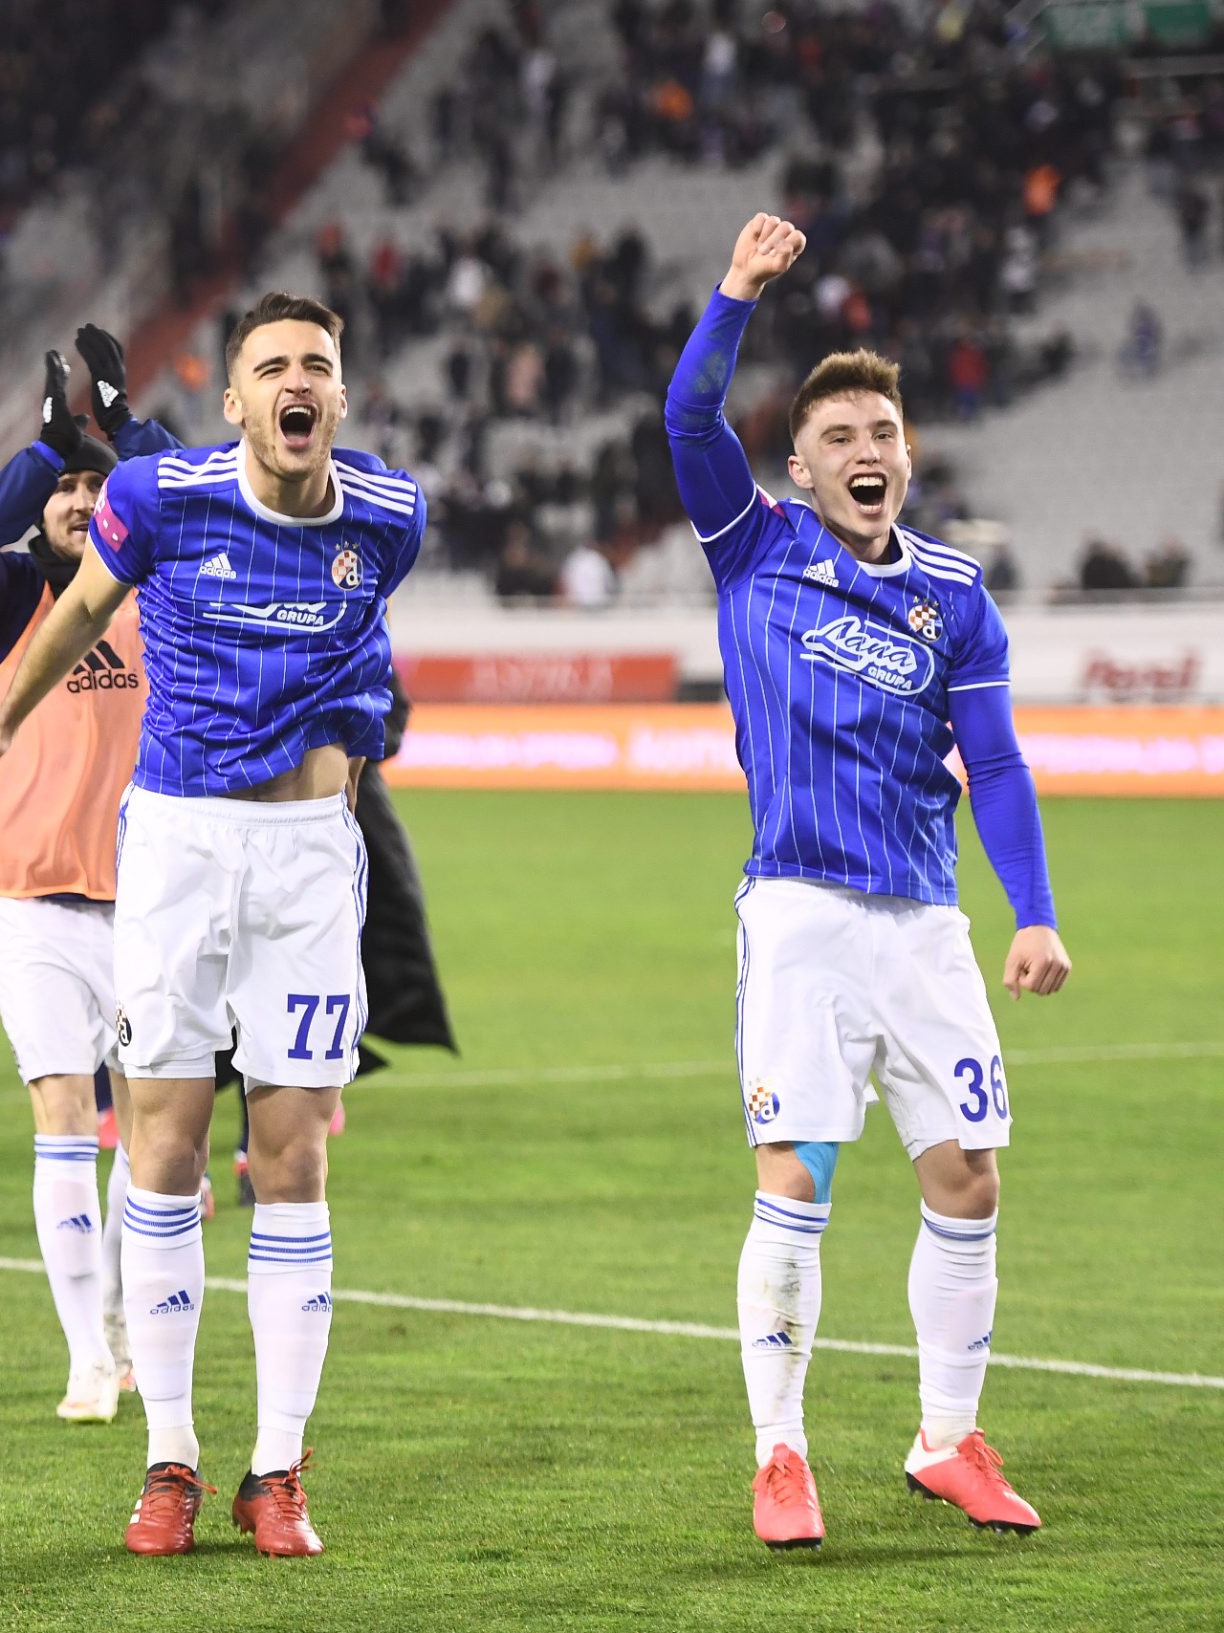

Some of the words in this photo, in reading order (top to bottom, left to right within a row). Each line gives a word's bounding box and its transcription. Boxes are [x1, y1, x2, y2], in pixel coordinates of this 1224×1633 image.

[200, 565, 237, 579] adidas
[803, 568, 839, 588] adidas
[277, 609, 324, 626] GRUPA
[801, 616, 917, 675] Lana
[67, 669, 139, 693] adidas
[867, 665, 912, 690] GRUPA
[287, 993, 350, 1060] 77
[954, 1055, 1008, 1122] 36
[150, 1303, 195, 1315] adidas
